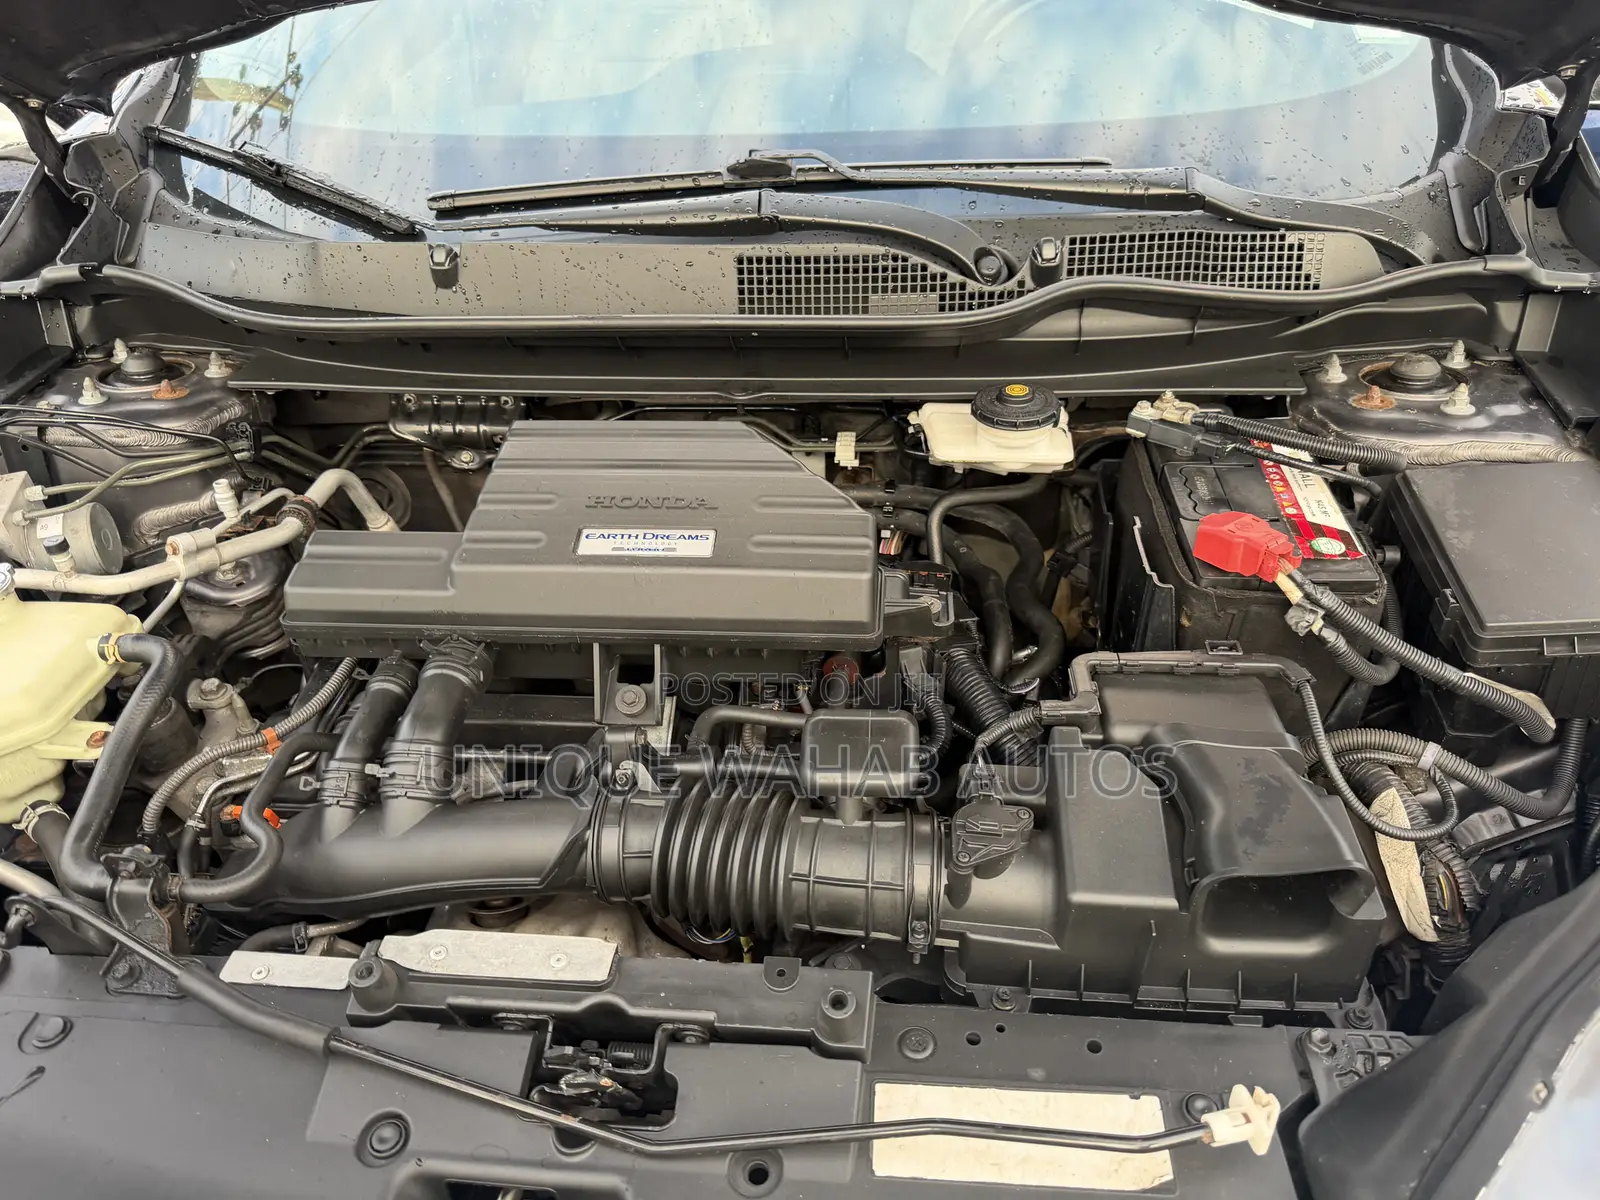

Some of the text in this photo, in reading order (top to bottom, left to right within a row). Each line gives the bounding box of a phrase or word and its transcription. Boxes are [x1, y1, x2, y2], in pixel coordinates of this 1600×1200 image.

[585, 495, 718, 510] HONDA
[584, 532, 710, 541] EARTH DREAMS
